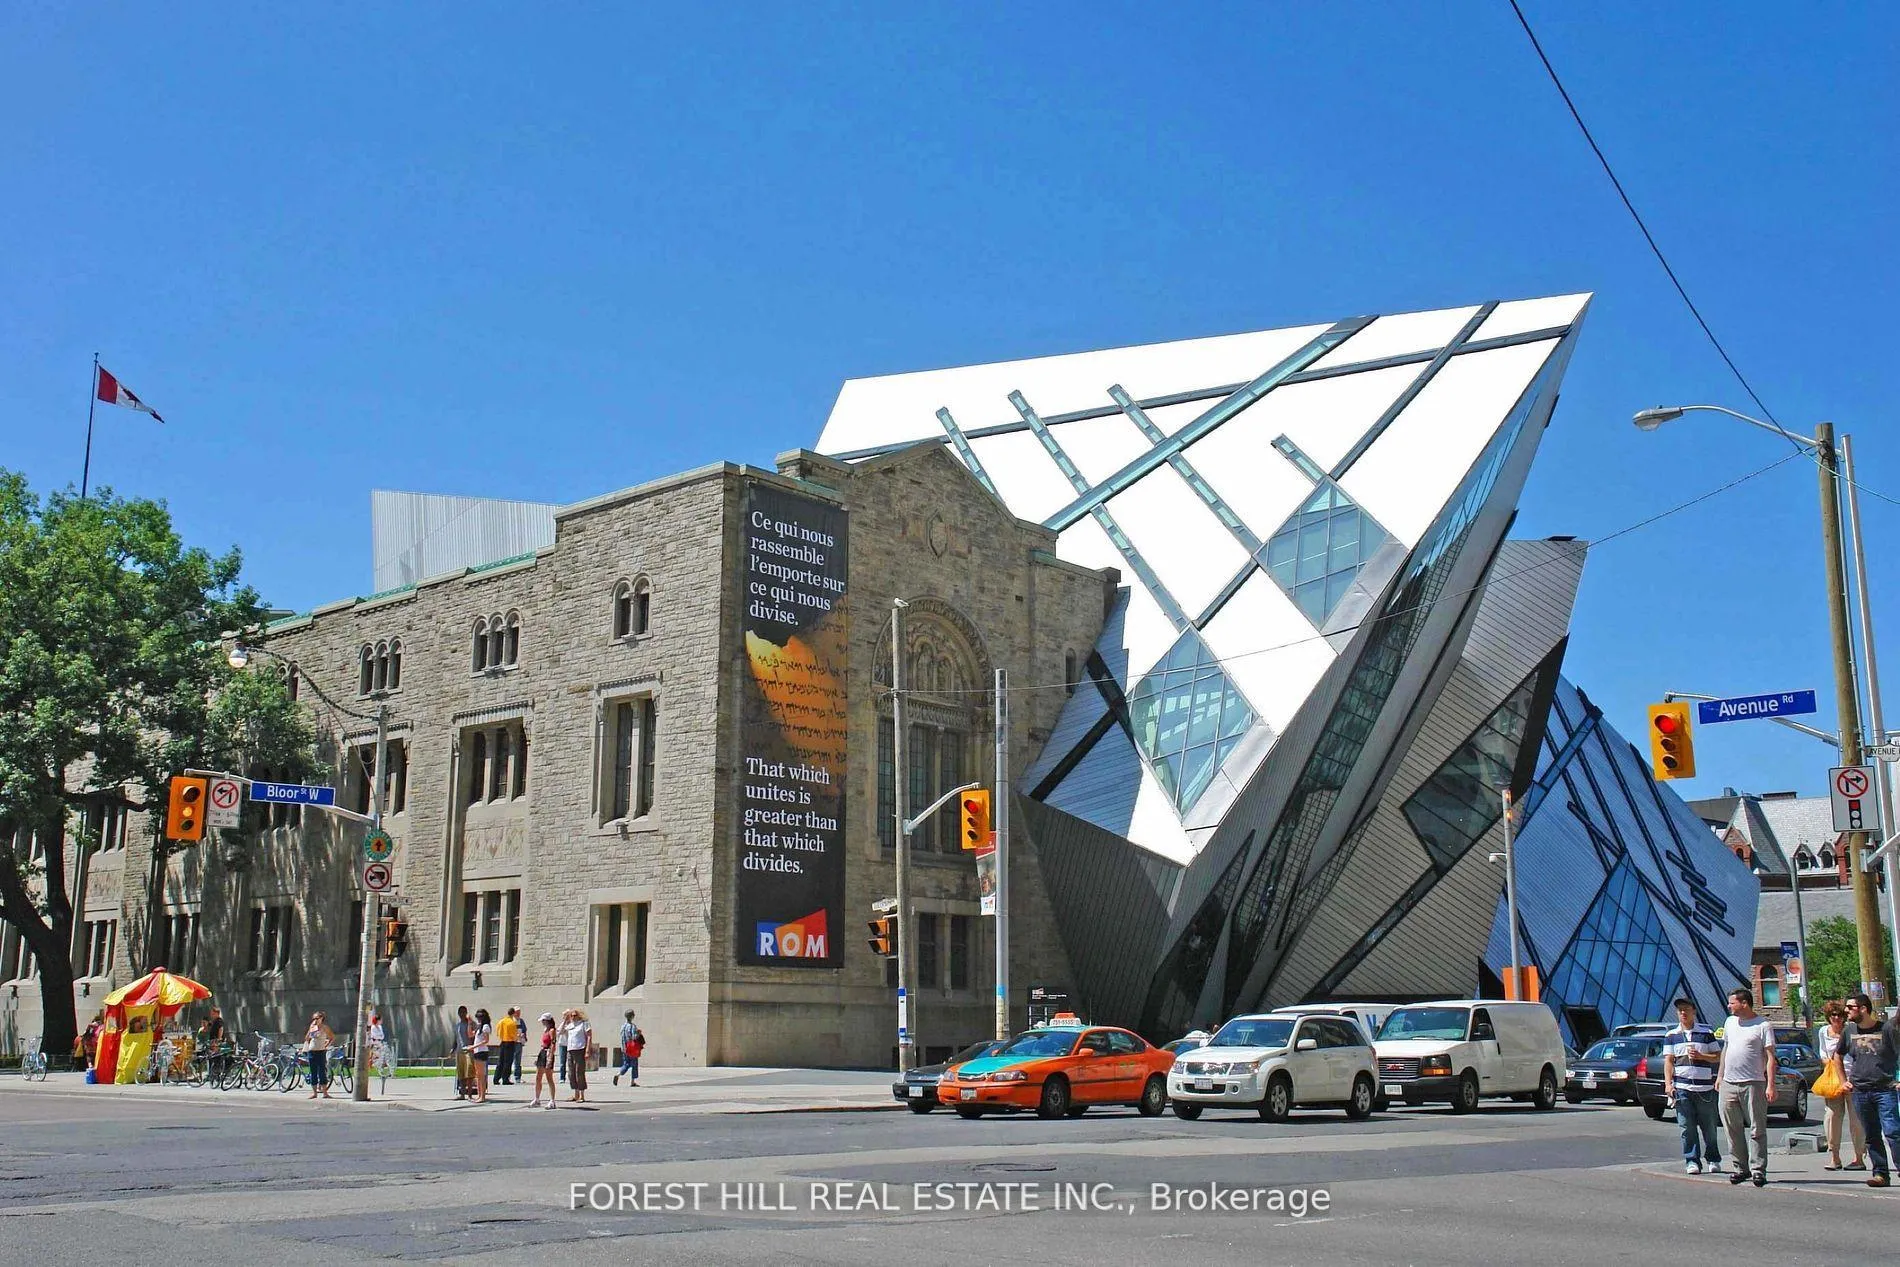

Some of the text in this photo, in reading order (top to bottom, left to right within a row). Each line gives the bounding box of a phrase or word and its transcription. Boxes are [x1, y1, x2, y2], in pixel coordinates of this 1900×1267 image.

[752, 511, 834, 547] Ce qui nous
[751, 536, 825, 565] rassemble
[750, 554, 845, 593] l’emporte sur
[750, 581, 767, 596] ce
[770, 586, 795, 603] qui
[798, 592, 831, 611] nous
[749, 600, 799, 626] divise.
[1719, 694, 1794, 717] Avenue Rd
[1870, 747, 1896, 755] AVENUE
[746, 757, 830, 785] That which
[267, 785, 319, 800] Bloor St W
[745, 782, 811, 804] unites is
[744, 808, 837, 831] greater than
[744, 828, 825, 852] that which
[743, 852, 803, 874] divides.
[760, 931, 825, 958] ROM
